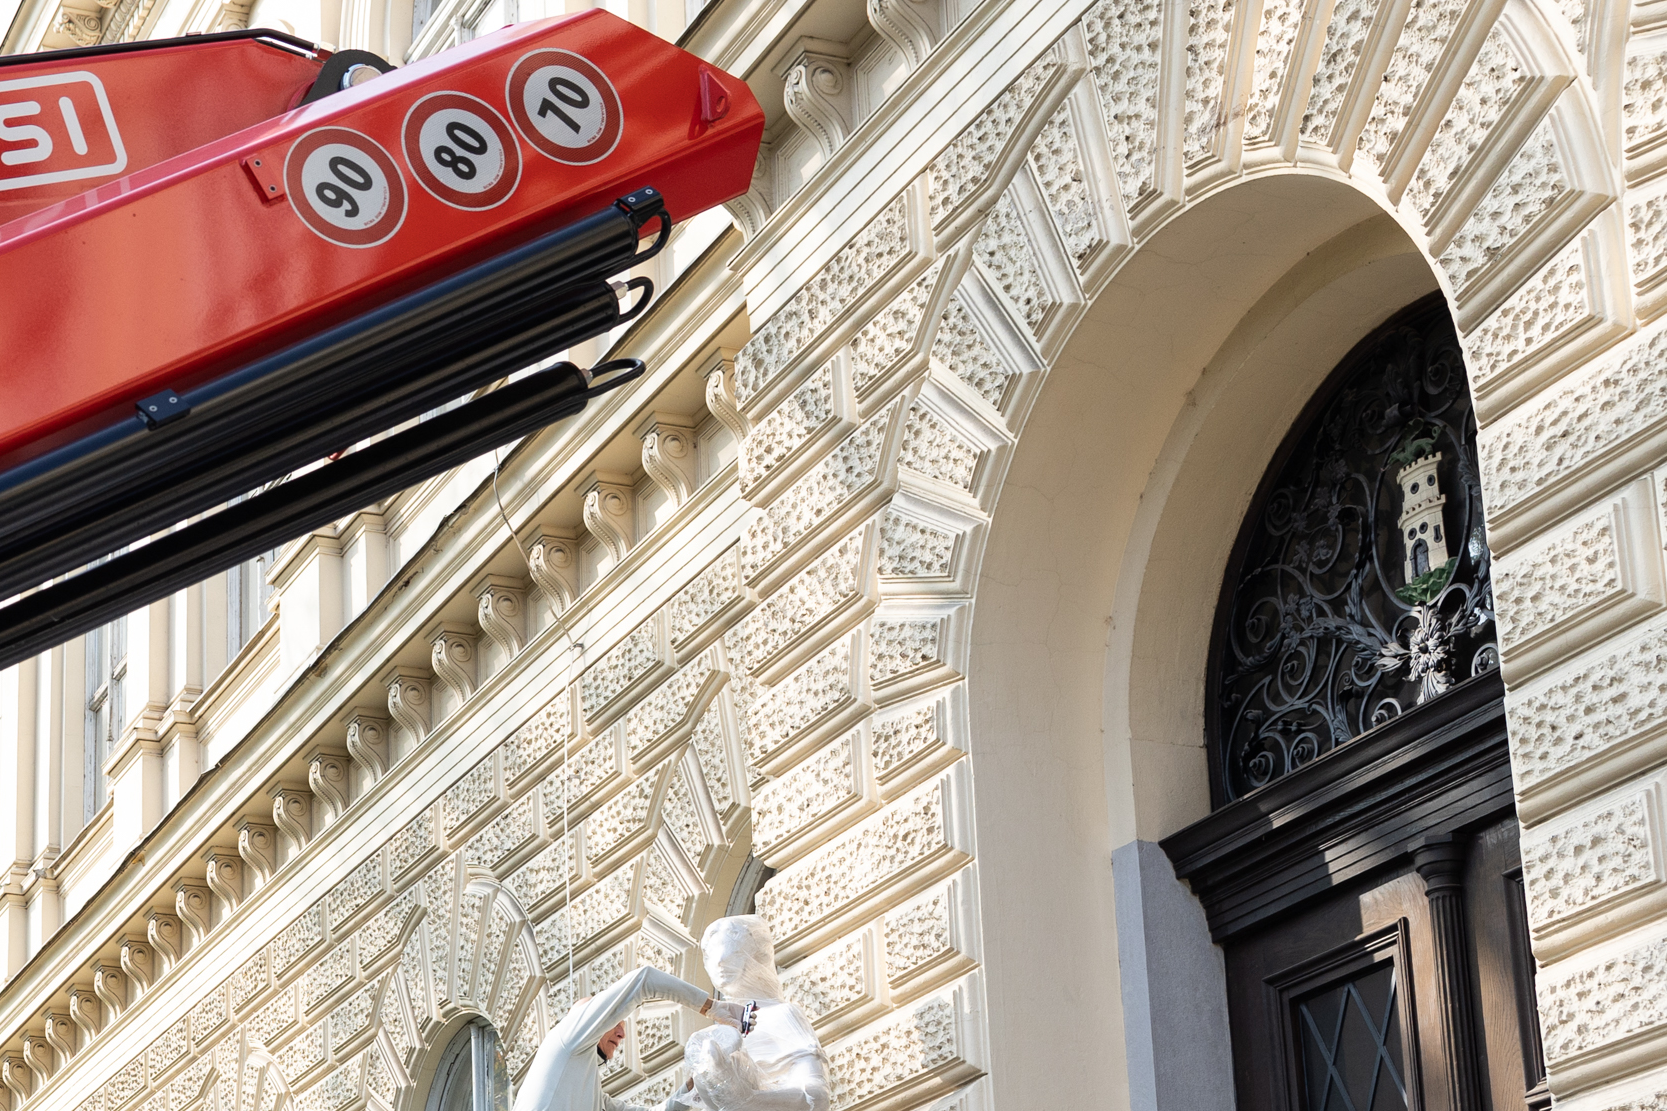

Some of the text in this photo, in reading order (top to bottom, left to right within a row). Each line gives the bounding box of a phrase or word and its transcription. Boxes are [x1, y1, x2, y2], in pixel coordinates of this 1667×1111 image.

[537, 77, 590, 134] 70
[434, 121, 488, 180] 80
[315, 156, 373, 218] 90
